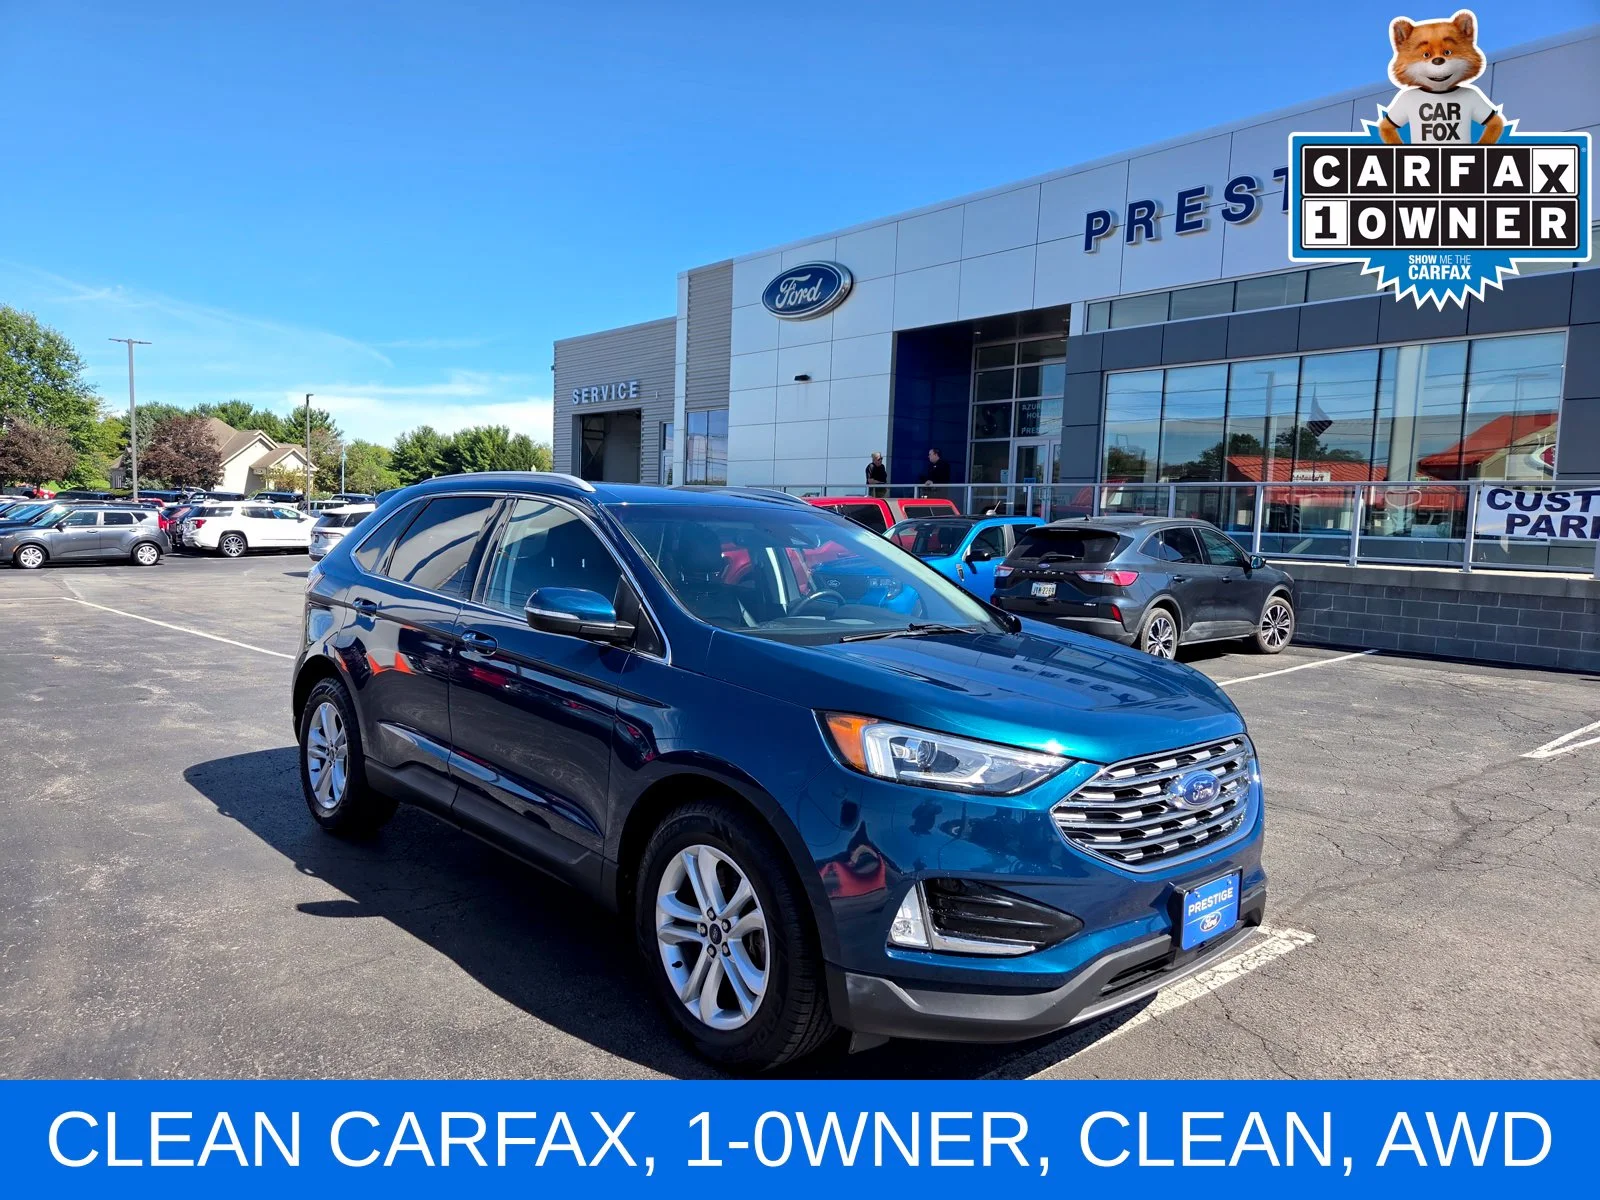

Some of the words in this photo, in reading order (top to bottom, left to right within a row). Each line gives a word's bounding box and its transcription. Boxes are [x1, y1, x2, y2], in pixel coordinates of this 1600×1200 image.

[775, 274, 823, 309] Ford
[572, 380, 639, 406] SERVICE
[1486, 488, 1600, 512] CUST
[1192, 778, 1214, 800] Ford
[1188, 886, 1234, 916] PRESTIGE
